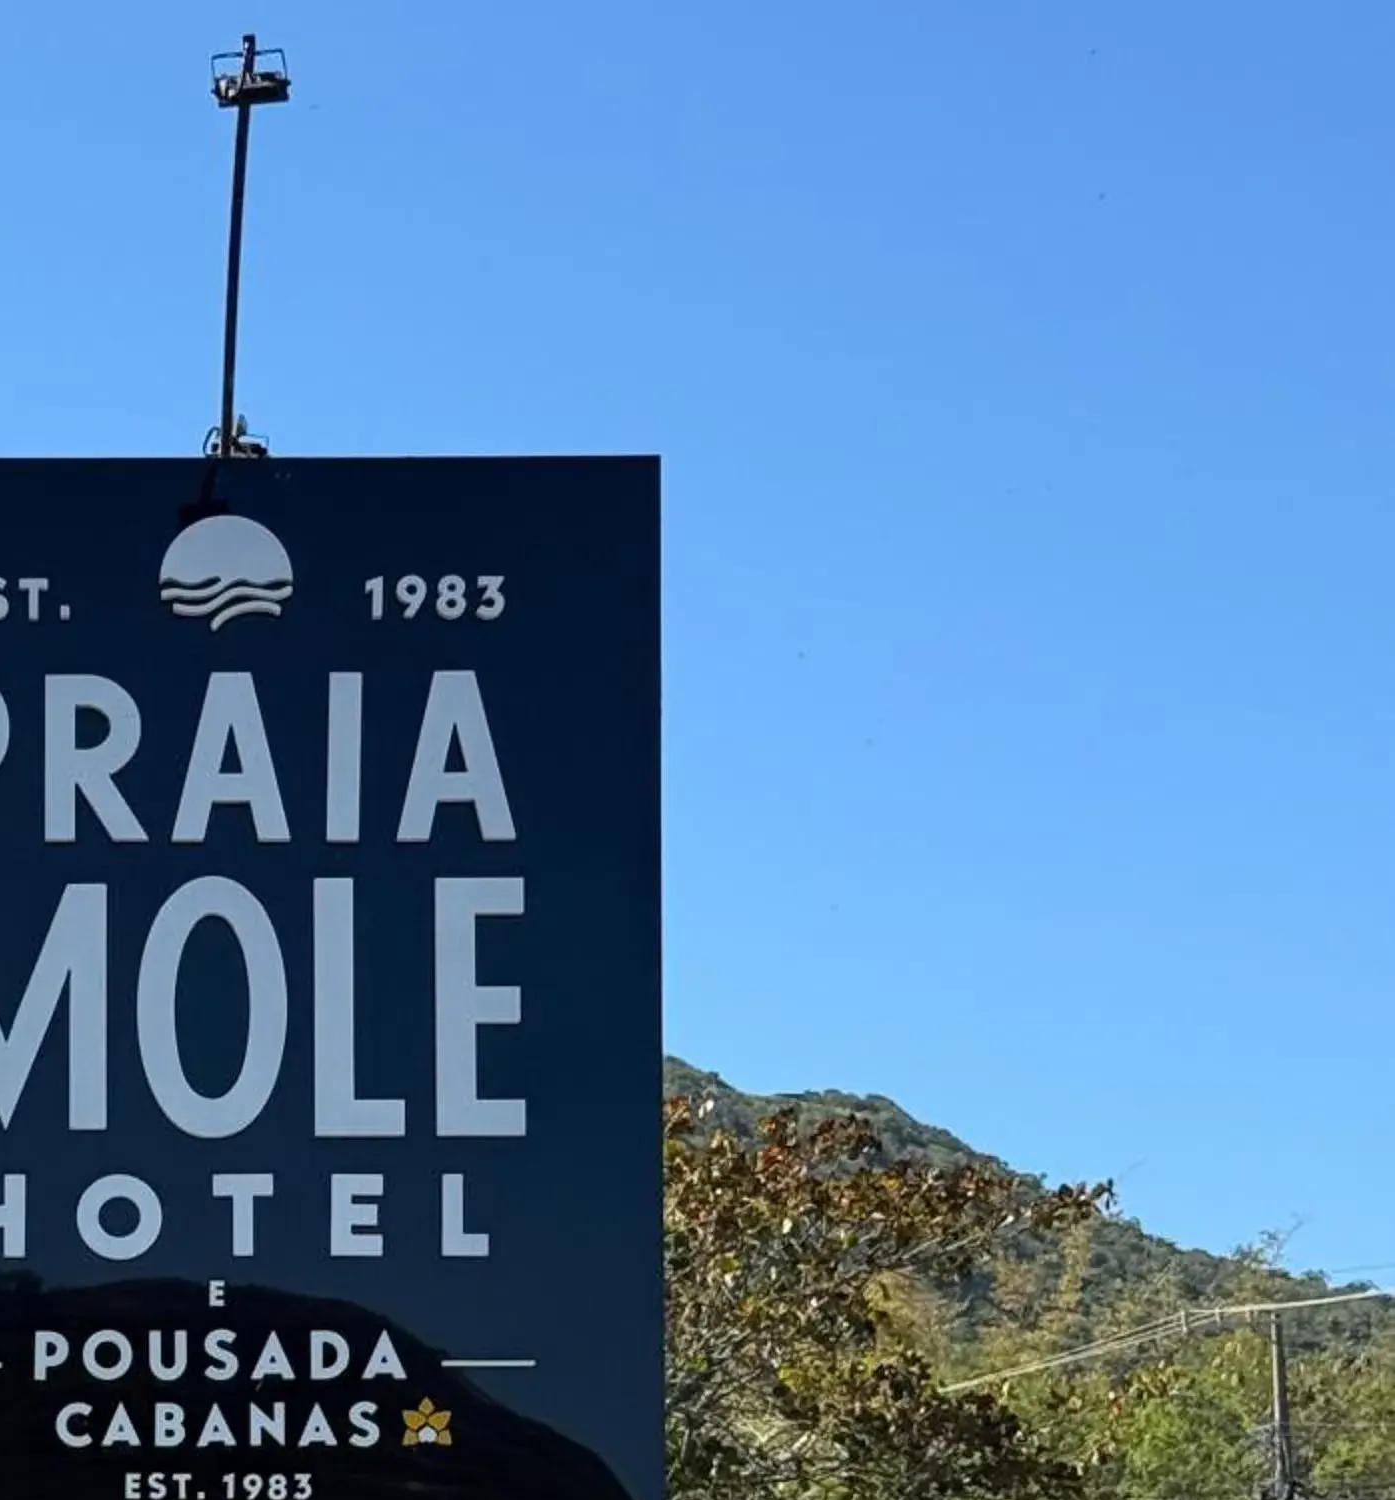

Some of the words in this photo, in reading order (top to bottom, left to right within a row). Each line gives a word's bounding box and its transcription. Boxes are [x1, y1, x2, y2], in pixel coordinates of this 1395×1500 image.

[364, 574, 506, 619] 1983
[208, 1280, 226, 1308] E
[34, 1329, 407, 1381] POUSADA
[55, 1402, 381, 1448] CABANAS
[124, 1472, 207, 1500] EST.
[222, 1473, 313, 1500] 1983
